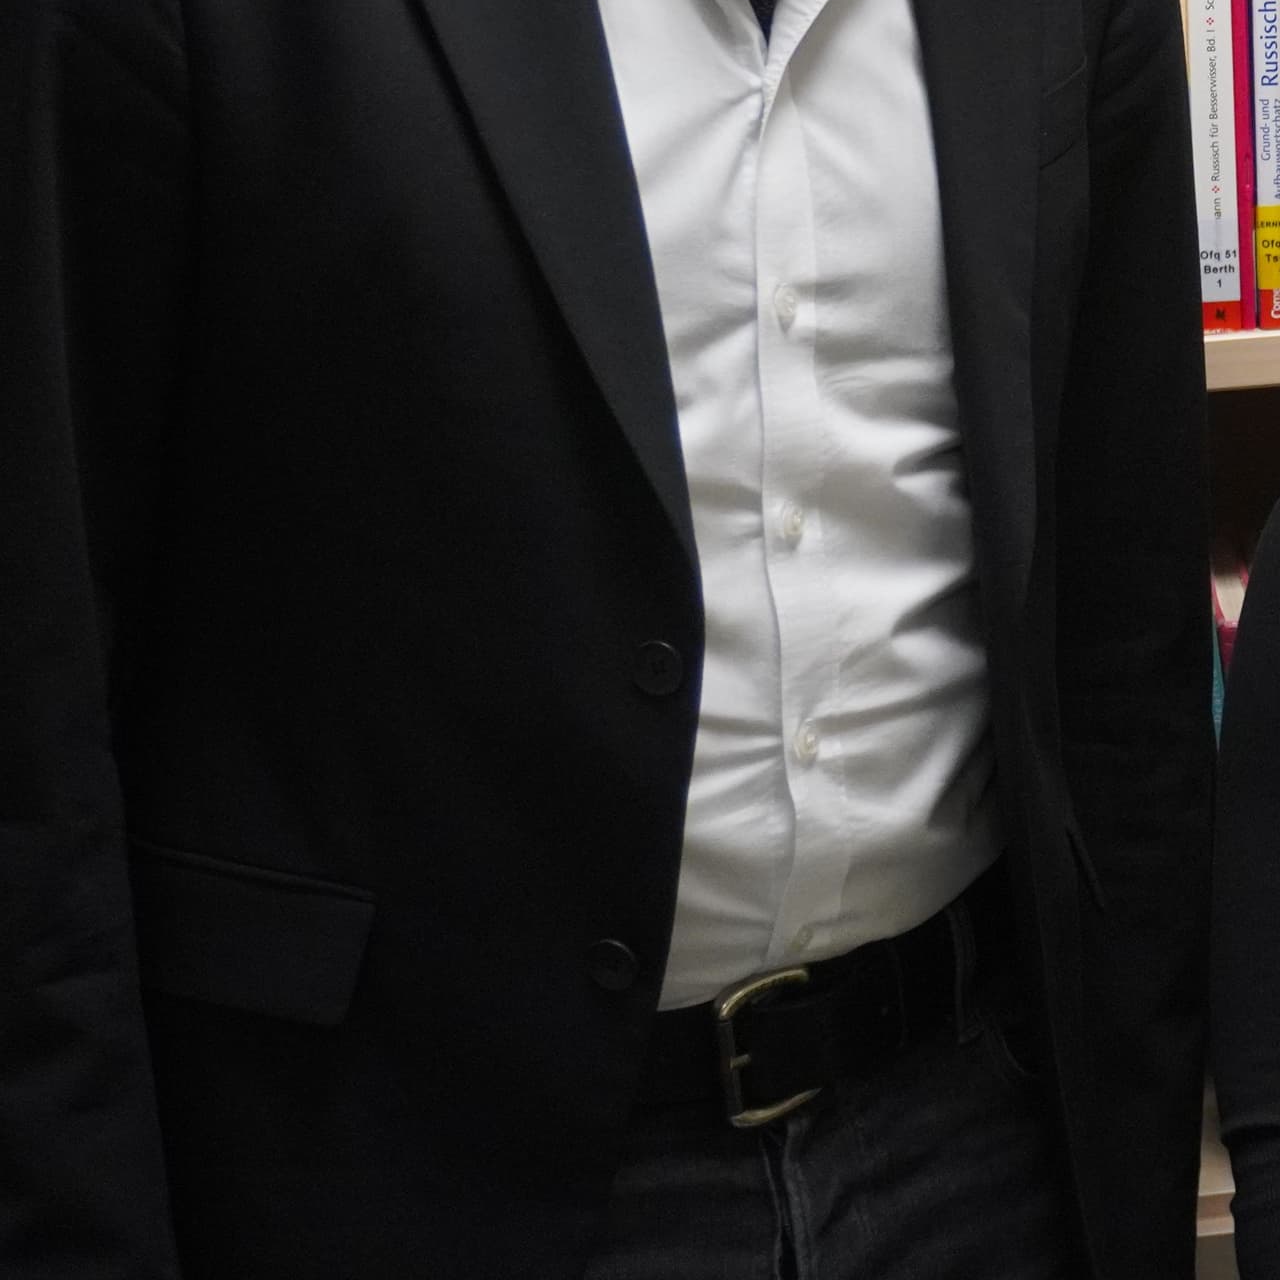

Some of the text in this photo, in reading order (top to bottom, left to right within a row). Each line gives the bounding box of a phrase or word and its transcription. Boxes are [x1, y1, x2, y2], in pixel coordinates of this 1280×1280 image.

[1257, 0, 1279, 87] Russisch
[1260, 99, 1271, 161] Grund- und
[1210, 134, 1221, 183] Russisch
[1203, 264, 1236, 274] Berth
